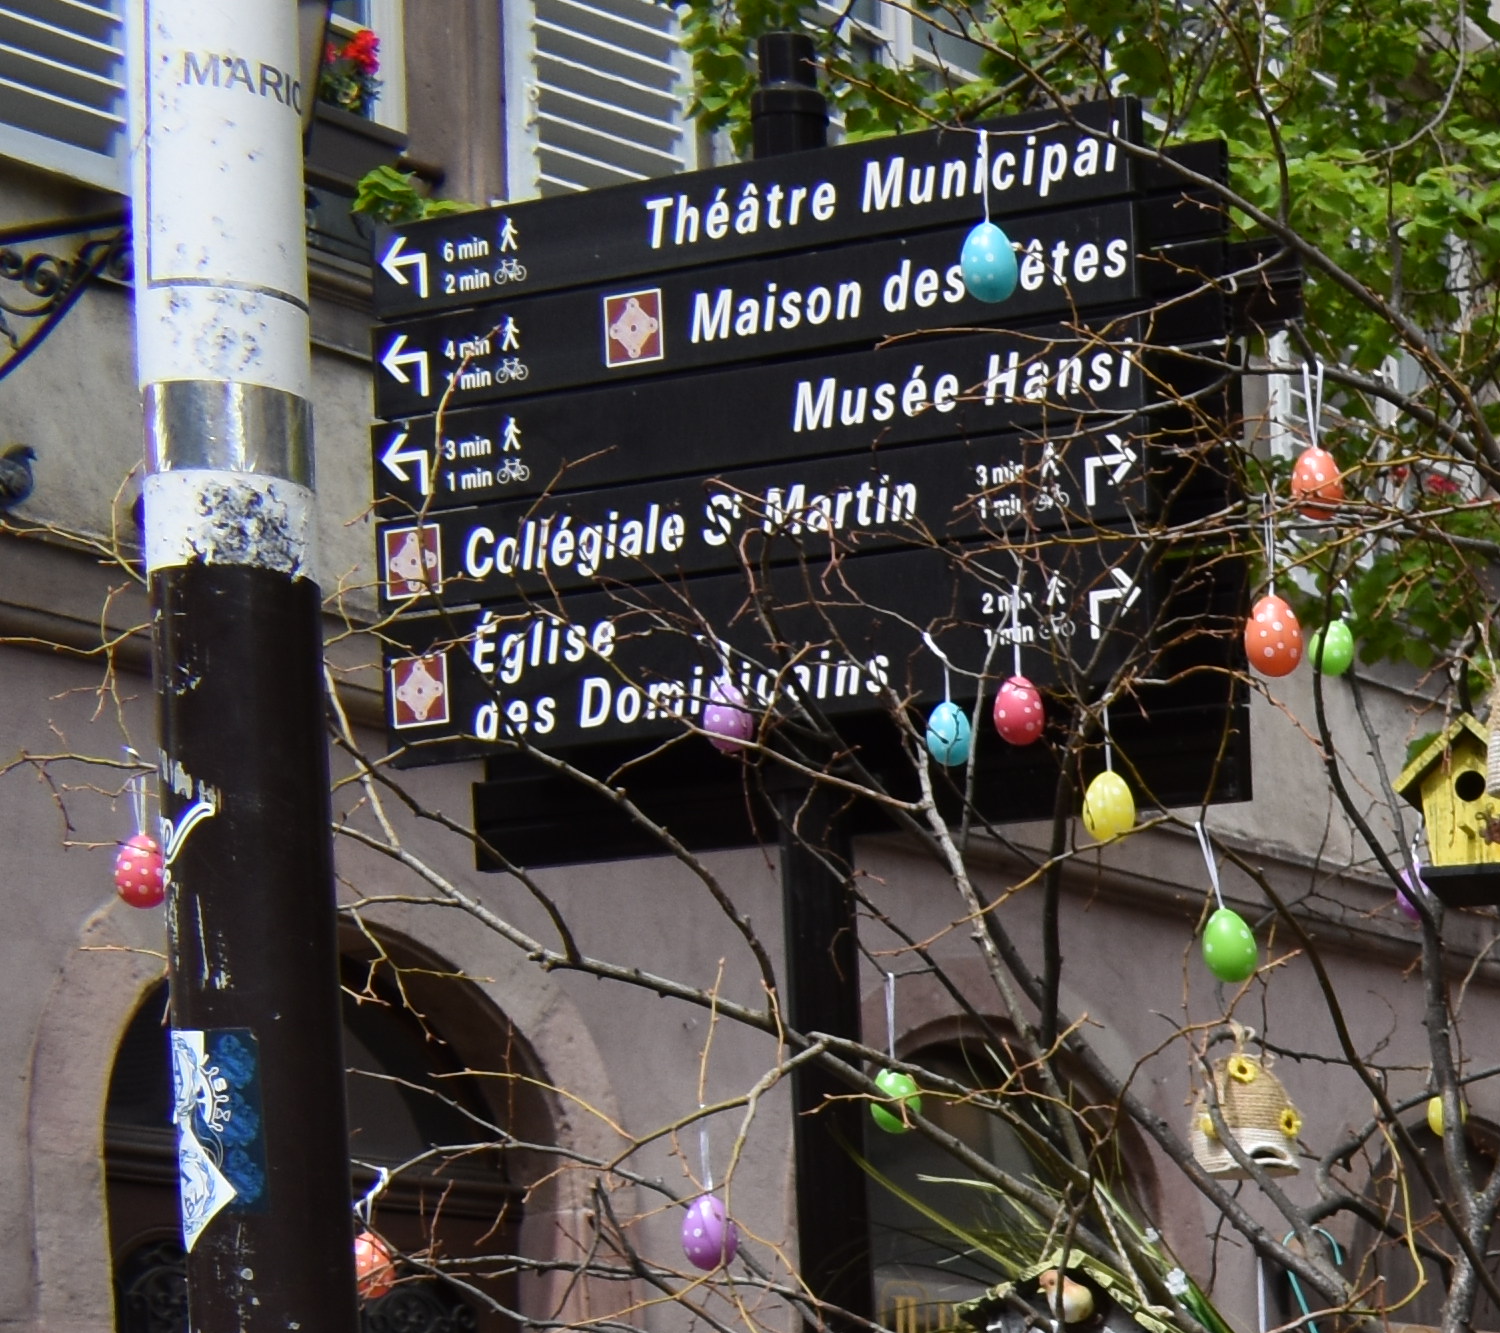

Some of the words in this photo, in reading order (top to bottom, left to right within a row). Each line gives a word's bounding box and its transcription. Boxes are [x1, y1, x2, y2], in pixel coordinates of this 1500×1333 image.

[646, 182, 837, 250] Théâtre
[861, 119, 1121, 213] Municipal
[443, 242, 455, 263] 6
[457, 236, 489, 261] min
[445, 275, 456, 294] 2
[458, 269, 490, 293] min
[691, 270, 862, 344] Maison
[883, 258, 965, 313] des
[1011, 236, 1128, 292] êtes
[444, 340, 455, 360] 4
[459, 336, 490, 358] min
[460, 368, 492, 390] min
[792, 363, 959, 433] Musée
[985, 338, 1134, 406] Hansi
[445, 440, 456, 461] 3
[460, 436, 491, 458] min
[447, 471, 456, 492] 1
[461, 467, 493, 490] min
[975, 464, 988, 486] 3
[992, 460, 1025, 484] min
[977, 498, 987, 519] 1
[466, 503, 686, 579] Collégiale
[762, 474, 917, 535] Martin
[982, 592, 994, 615] 2
[998, 592, 1033, 612] mn
[473, 611, 616, 684] Église
[983, 628, 993, 647] 1
[475, 689, 556, 741] des
